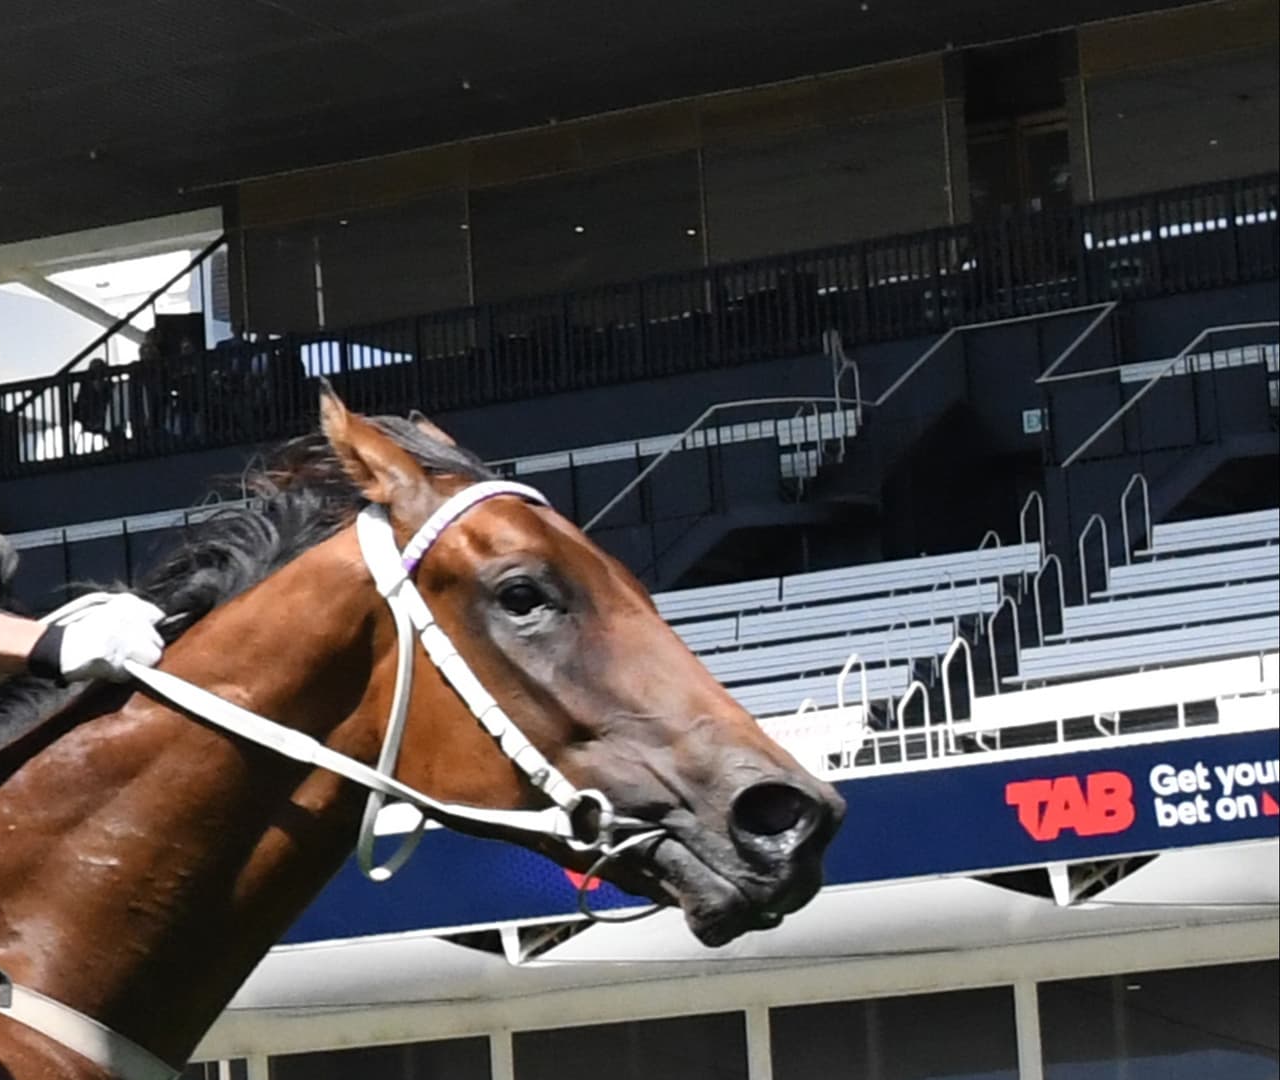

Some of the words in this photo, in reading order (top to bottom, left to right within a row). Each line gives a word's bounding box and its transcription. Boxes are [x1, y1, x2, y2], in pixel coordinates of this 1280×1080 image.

[1149, 761, 1212, 796] Get
[1006, 771, 1136, 841] TAB
[1154, 794, 1212, 827] bet
[1215, 794, 1258, 821] on
